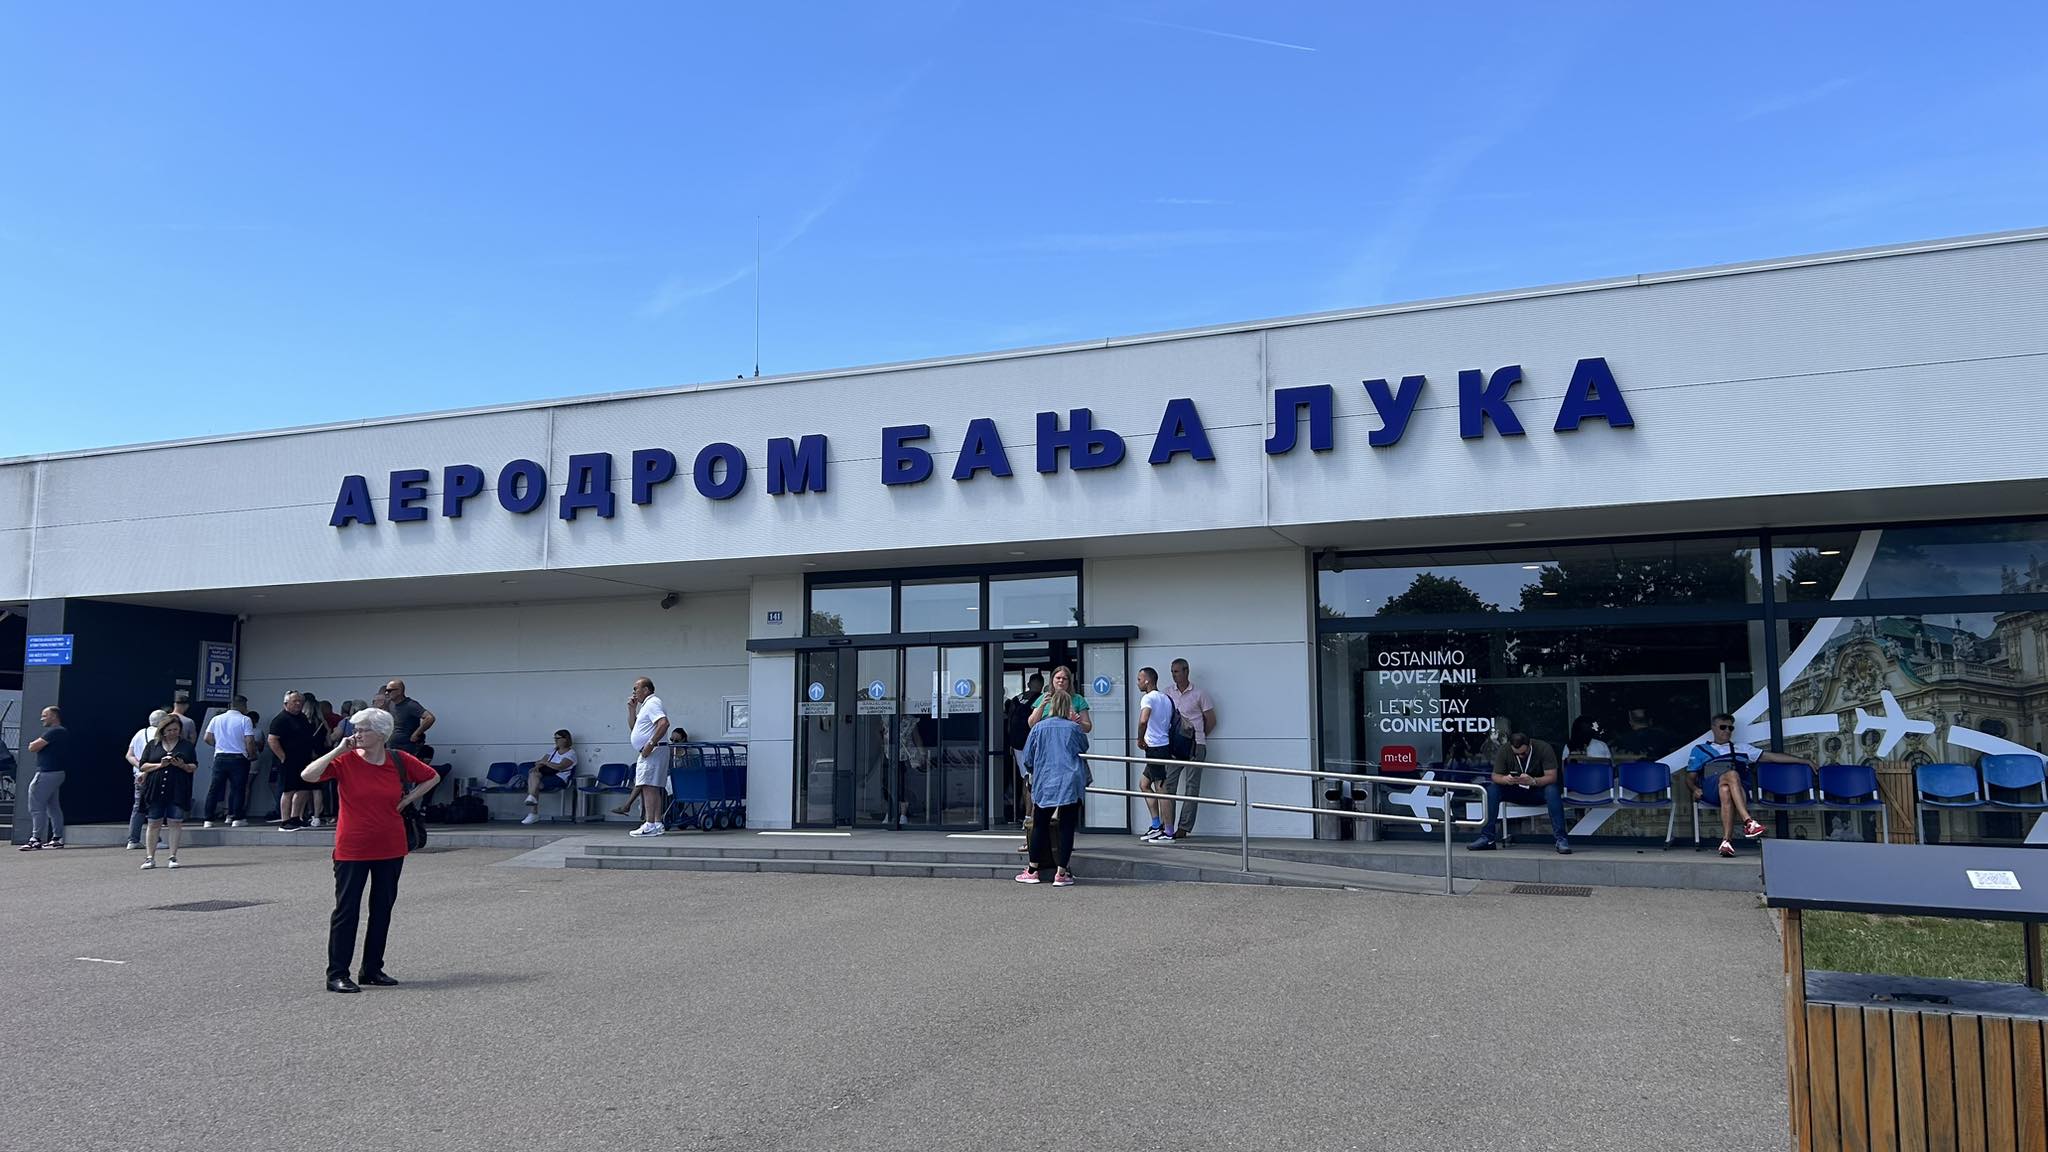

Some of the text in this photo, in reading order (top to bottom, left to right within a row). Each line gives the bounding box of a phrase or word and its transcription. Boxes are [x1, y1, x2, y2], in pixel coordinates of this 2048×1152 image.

[332, 357, 1634, 527] АЕРОДРОМ БАЊА ЛУКА
[1378, 650, 1465, 666] OSTANIMO
[210, 661, 225, 684] P
[1379, 668, 1477, 684] POVEZANI!
[1379, 698, 1470, 714] LET'S STAY
[1379, 717, 1496, 733] CONNECTED!
[1384, 752, 1412, 763] m:tel
